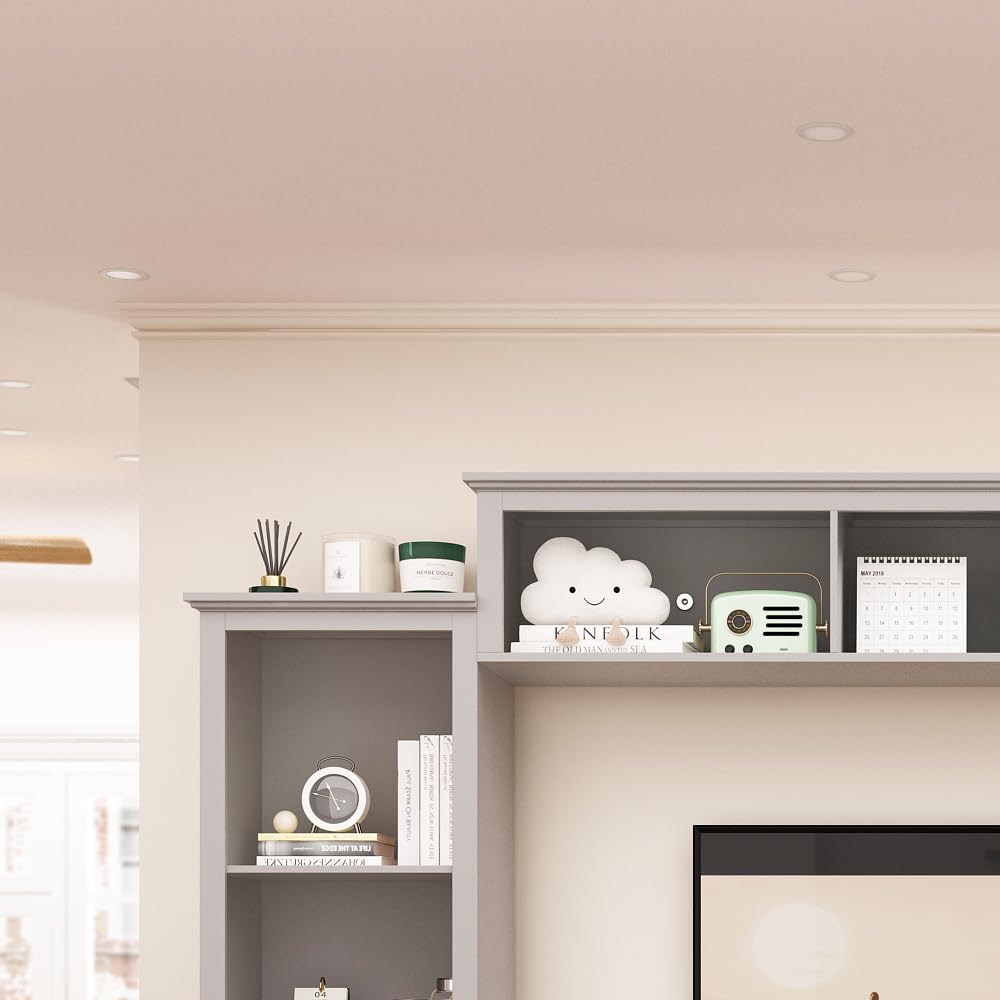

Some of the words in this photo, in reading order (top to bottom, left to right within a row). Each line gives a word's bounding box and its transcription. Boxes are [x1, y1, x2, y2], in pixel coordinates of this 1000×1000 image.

[554, 626, 662, 640] KNFLK
[562, 645, 582, 653] OLD
[630, 645, 648, 653] SEA
